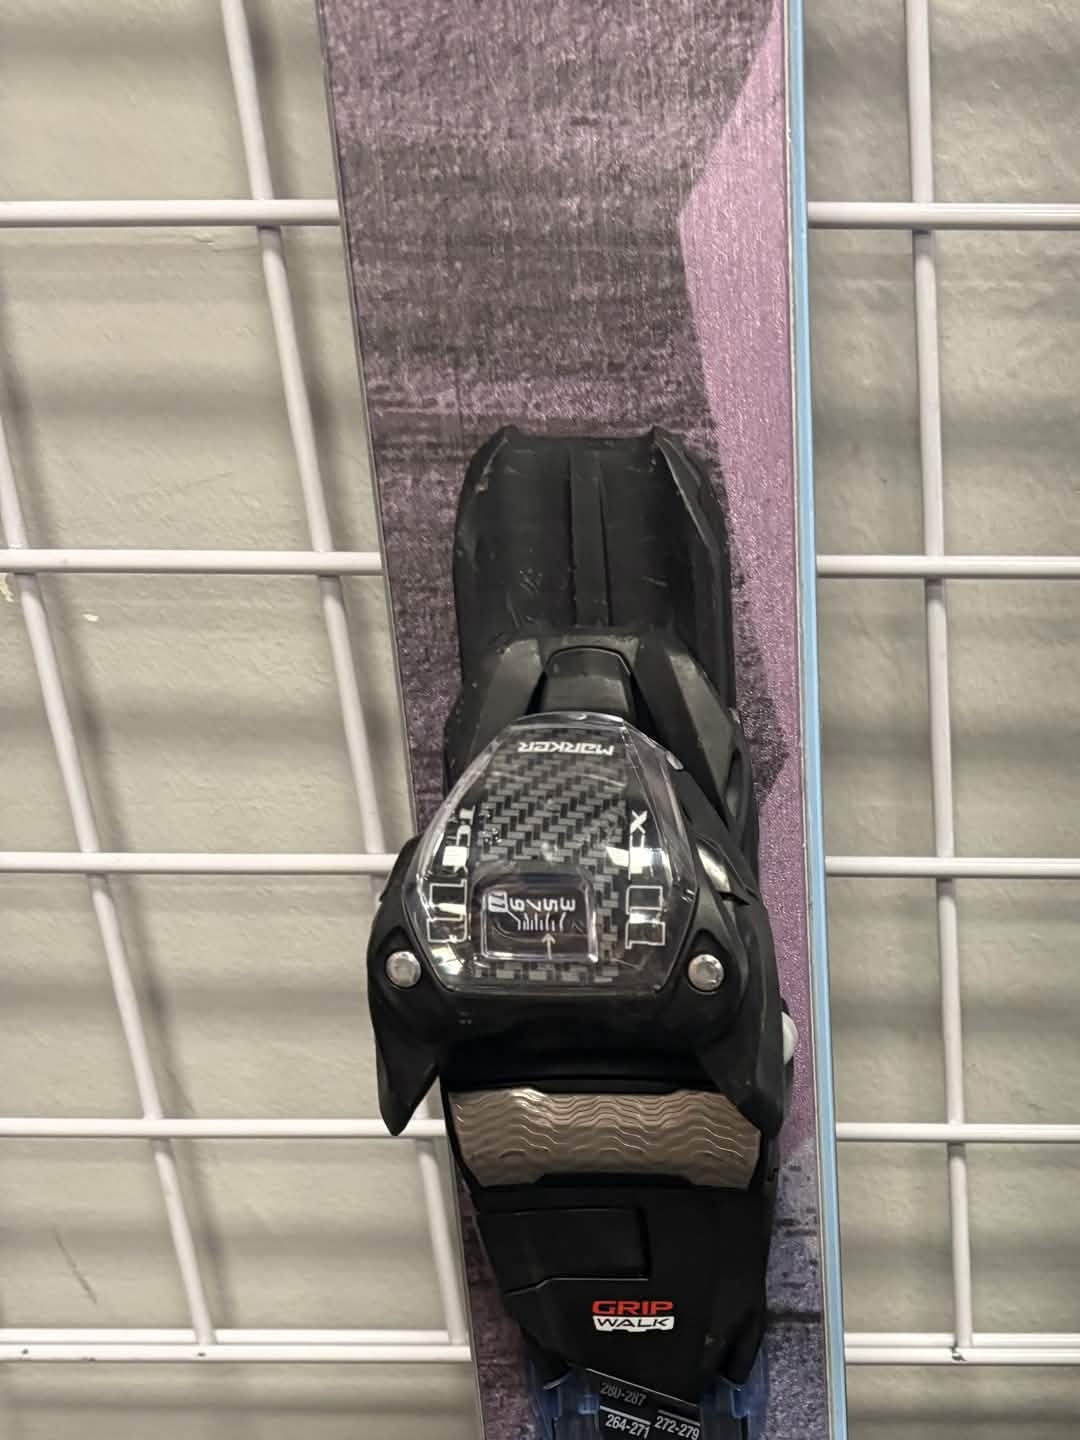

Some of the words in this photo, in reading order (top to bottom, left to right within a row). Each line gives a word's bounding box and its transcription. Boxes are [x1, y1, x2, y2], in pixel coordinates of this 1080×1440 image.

[518, 740, 615, 755] MARKER
[592, 1300, 674, 1316] GRIP
[595, 1317, 671, 1329] WALK
[605, 1414, 650, 1439] 264-271
[654, 1416, 700, 1440] 272-279
